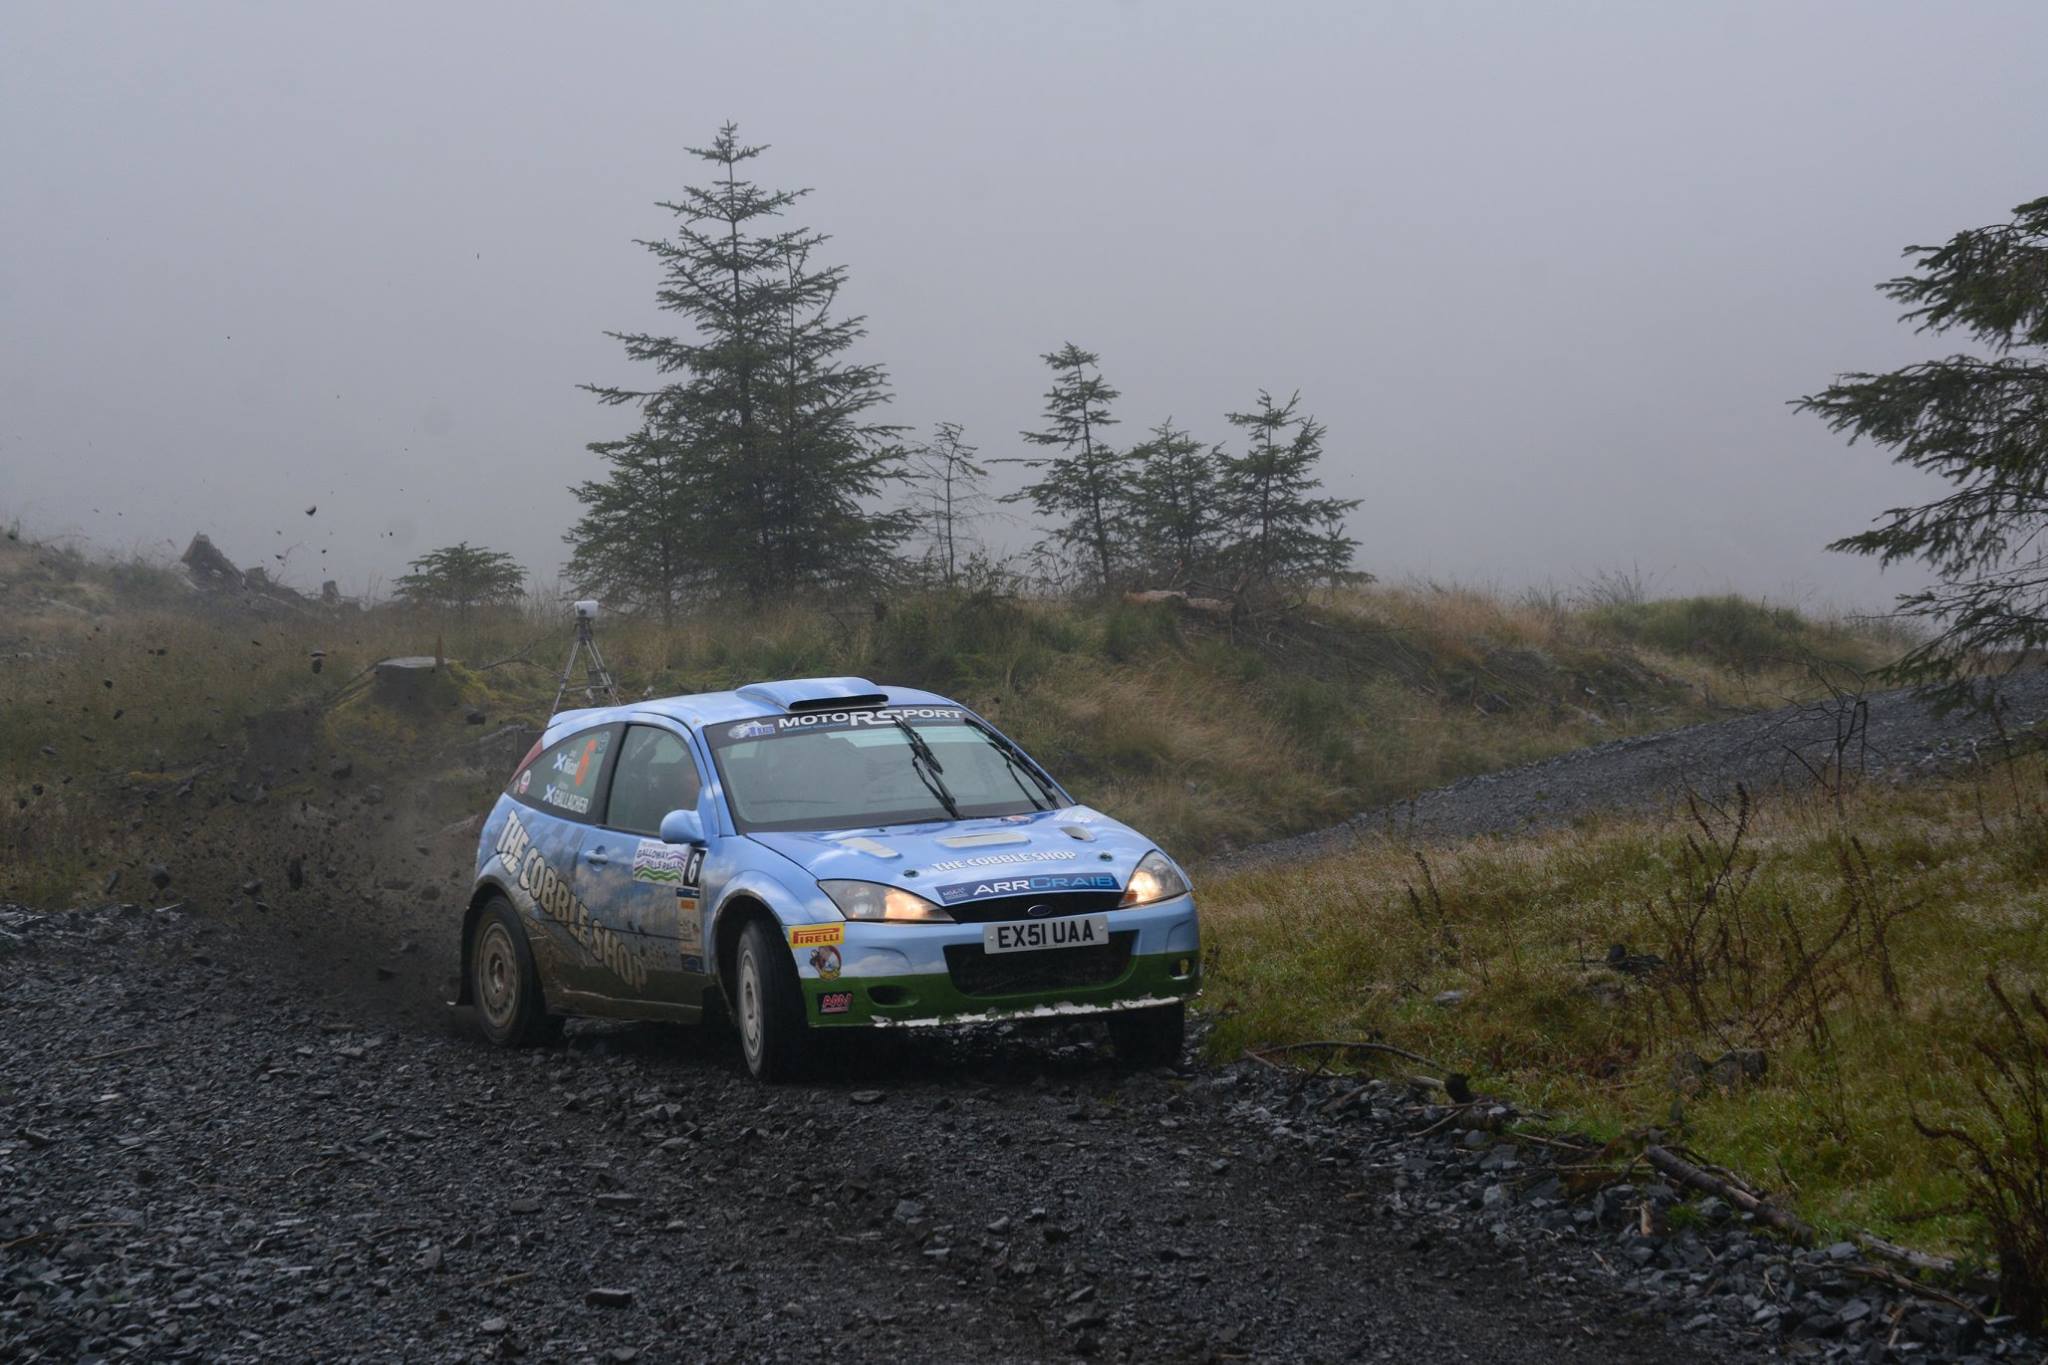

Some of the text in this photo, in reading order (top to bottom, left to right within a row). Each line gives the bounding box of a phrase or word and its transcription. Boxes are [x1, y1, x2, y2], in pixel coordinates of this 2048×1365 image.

[779, 709, 962, 728] MOTORSPORT
[688, 852, 700, 884] 6
[932, 851, 1077, 871] THE COBBLE SHOP
[496, 808, 648, 991] THE COBBLE SHOP
[793, 927, 840, 944] PIRELLI
[997, 919, 1094, 949] EX51 UAA
